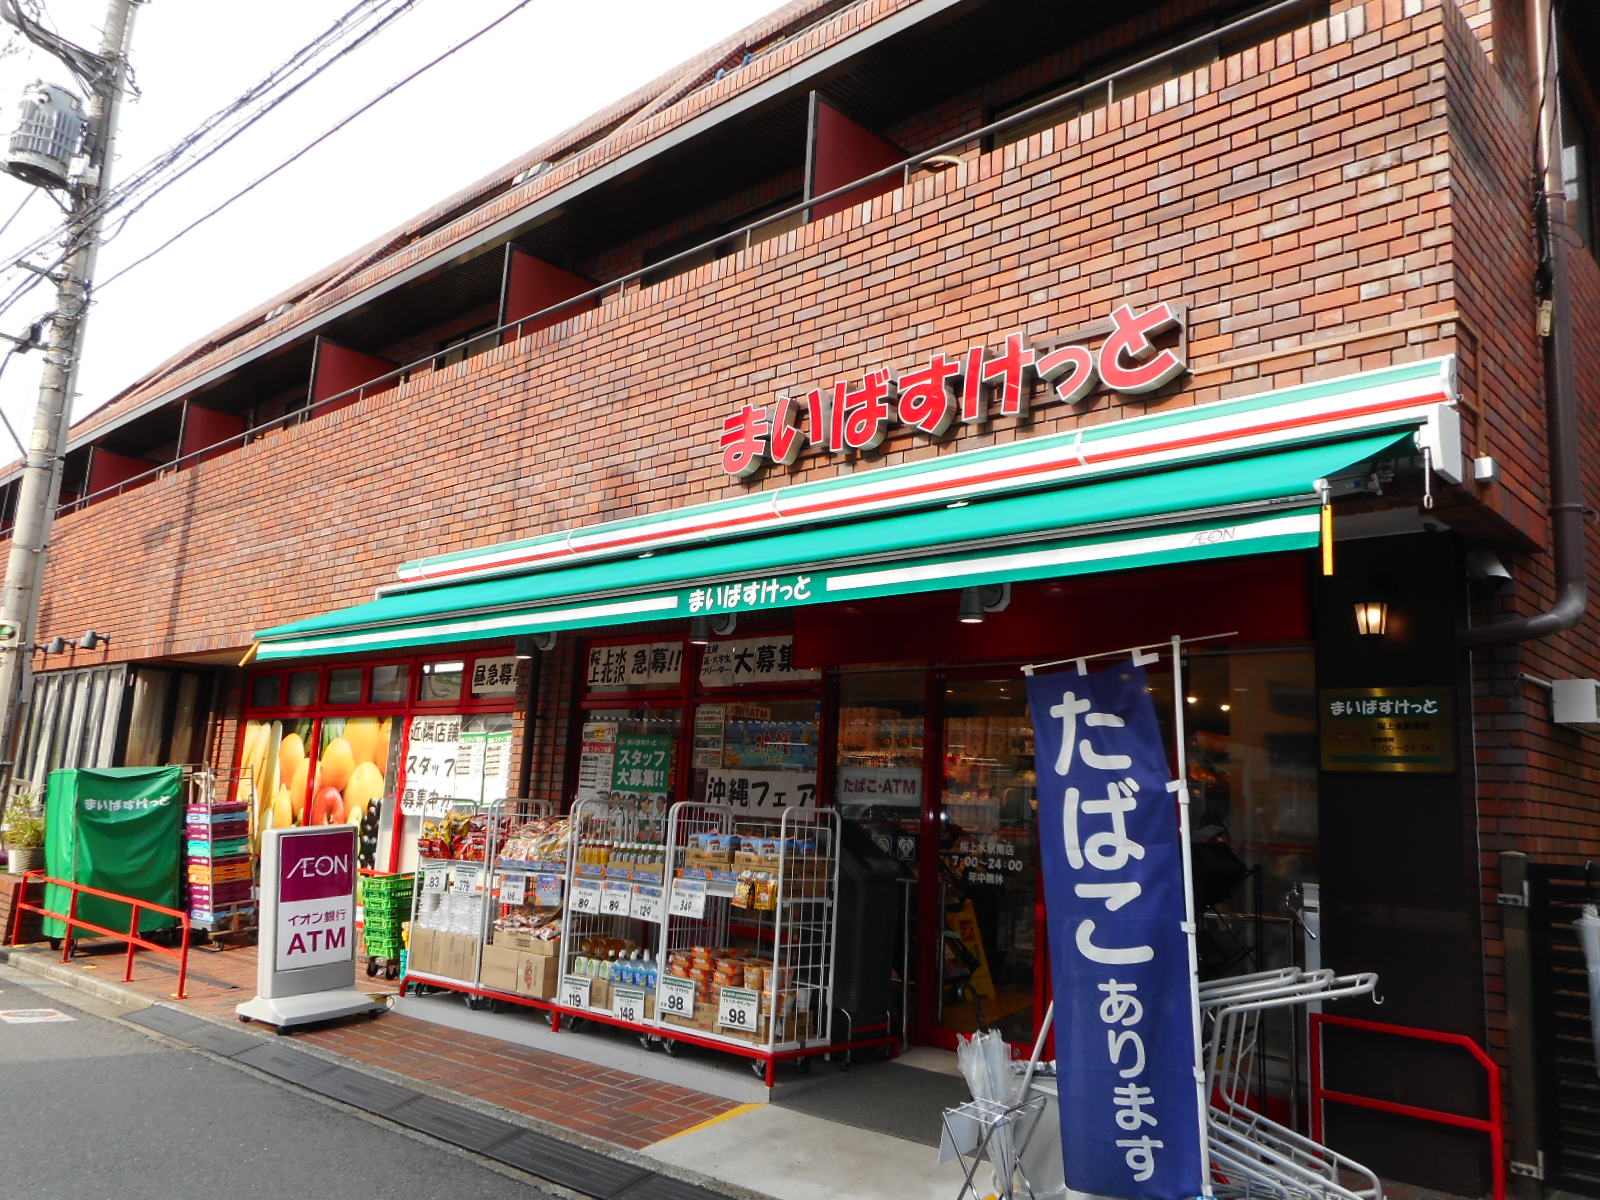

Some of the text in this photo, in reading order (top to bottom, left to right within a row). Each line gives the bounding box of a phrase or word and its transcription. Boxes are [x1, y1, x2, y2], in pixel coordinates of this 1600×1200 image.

[719, 301, 1186, 477] まいばすけっと
[688, 575, 812, 613] まいばすけっと
[588, 665, 626, 683] 上北沢
[1330, 699, 1439, 716] まいばすけっと
[406, 756, 456, 777] スタッフ
[619, 749, 666, 768] スタッフ
[616, 768, 665, 787] 大募集!!
[707, 776, 816, 807] 沖縄フェア
[84, 795, 171, 812] まいばすけっと
[287, 909, 346, 926] イオン銀行
[287, 926, 346, 956] ATM
[569, 993, 582, 1007] 119
[667, 995, 684, 1011] 98
[619, 1006, 635, 1022] 148
[728, 1008, 746, 1025] 98
